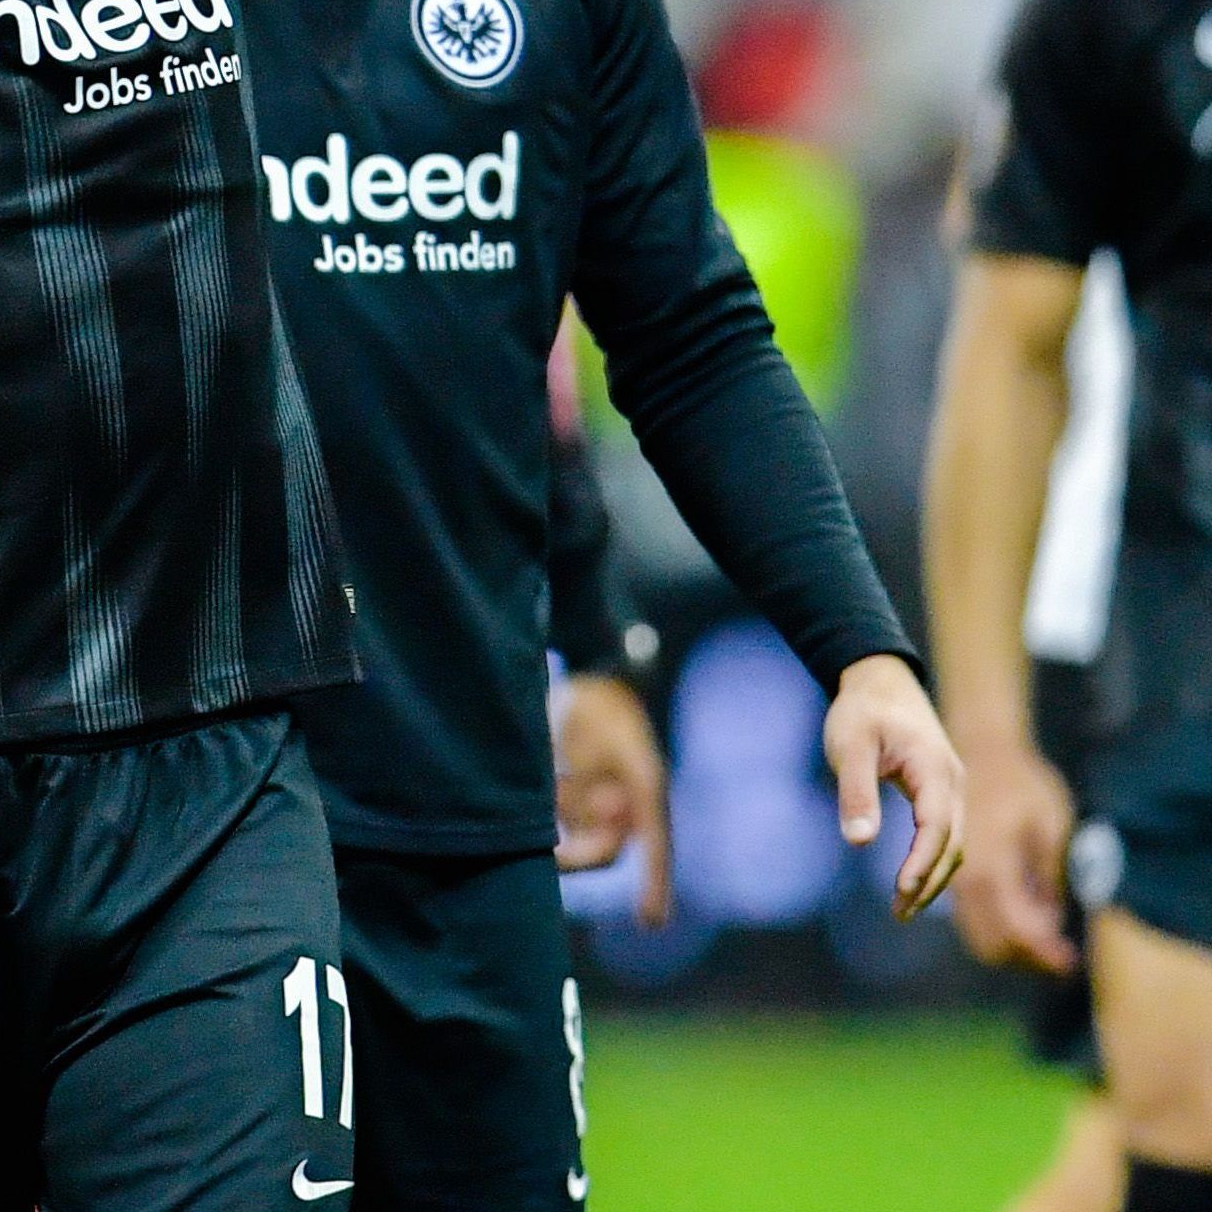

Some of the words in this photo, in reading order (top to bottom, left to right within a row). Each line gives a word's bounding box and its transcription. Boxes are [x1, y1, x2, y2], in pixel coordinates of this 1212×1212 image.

[63, 66, 153, 114] Jobs
[159, 47, 243, 96] finden
[261, 130, 520, 225] ndeed
[313, 233, 405, 273] Jobs
[413, 230, 516, 271] finden
